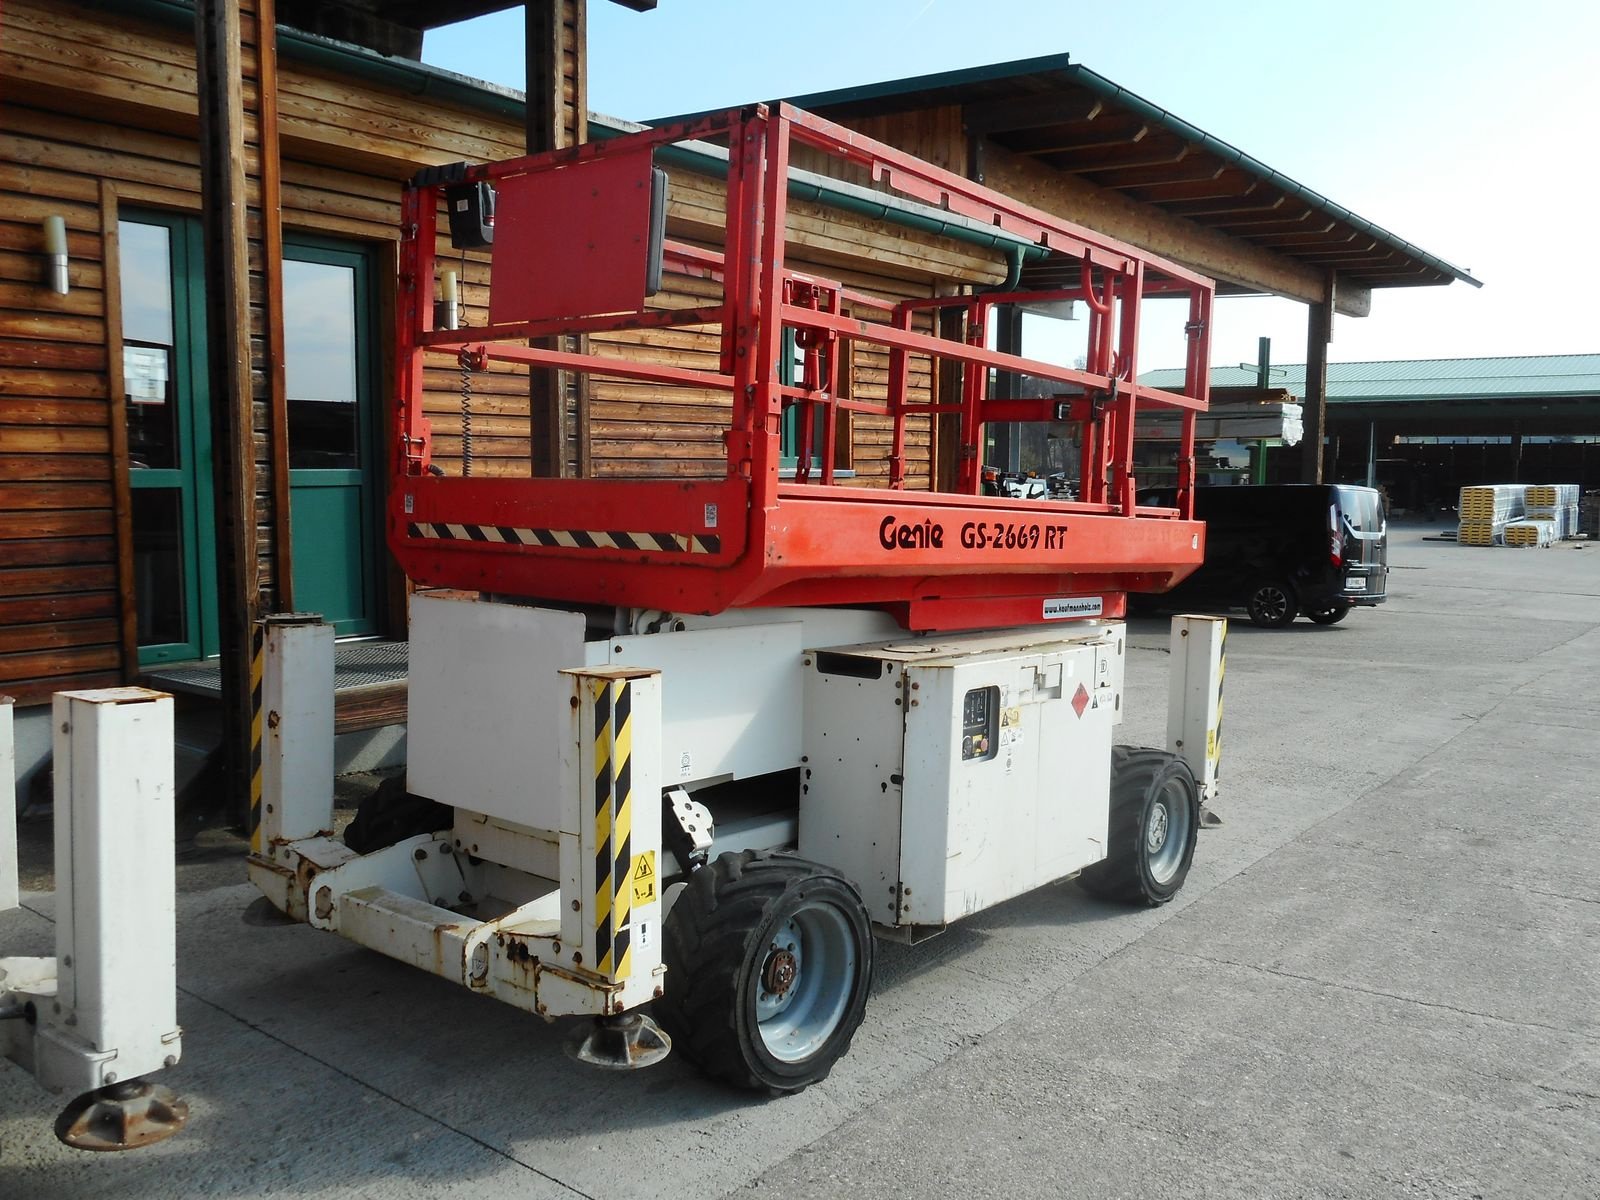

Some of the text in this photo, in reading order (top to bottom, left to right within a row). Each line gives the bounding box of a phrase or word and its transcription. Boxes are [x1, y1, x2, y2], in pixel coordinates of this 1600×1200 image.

[879, 515, 1068, 551] Genie GS-2669 RT
